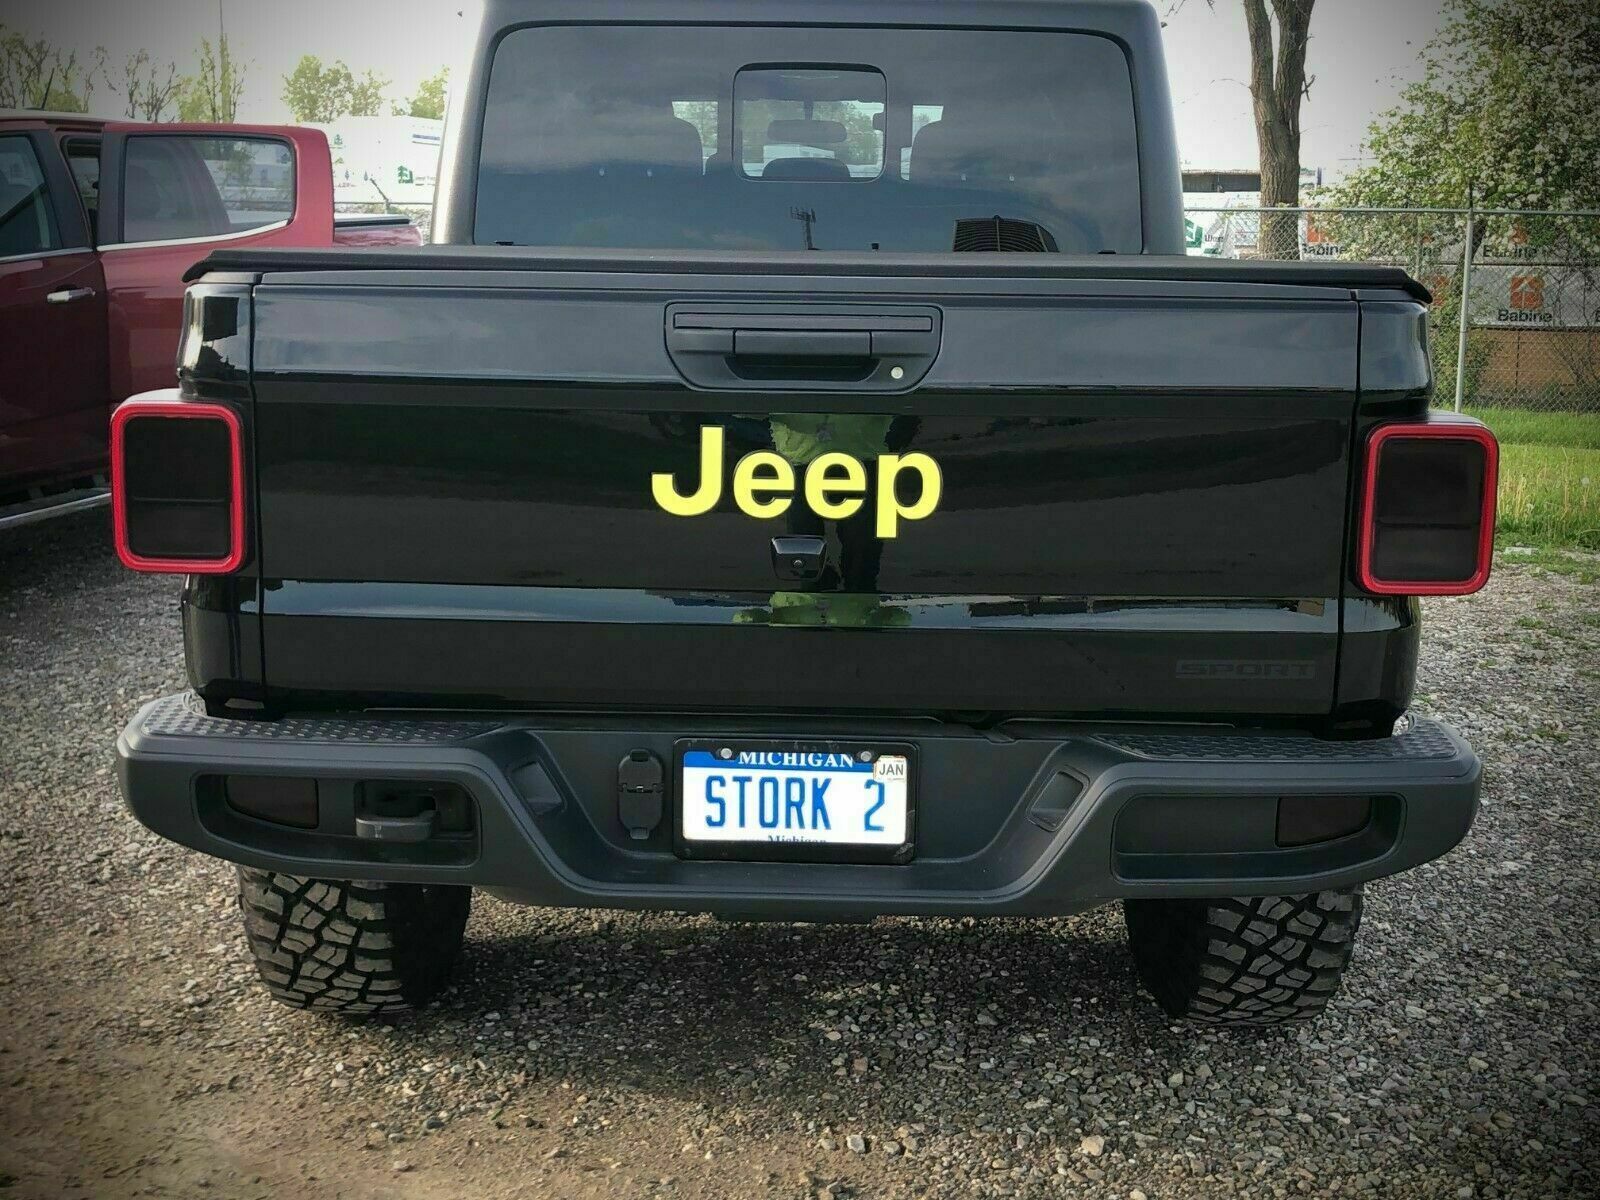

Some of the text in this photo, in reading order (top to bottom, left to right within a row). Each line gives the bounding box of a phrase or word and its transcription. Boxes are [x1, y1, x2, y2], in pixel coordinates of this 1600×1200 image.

[1498, 308, 1553, 323] Babine
[651, 424, 943, 539] Jeep
[1178, 662, 1311, 676] SPORT
[738, 752, 855, 768] MICHIGAN
[879, 763, 905, 776] JAN
[705, 775, 886, 832] STORK 2
